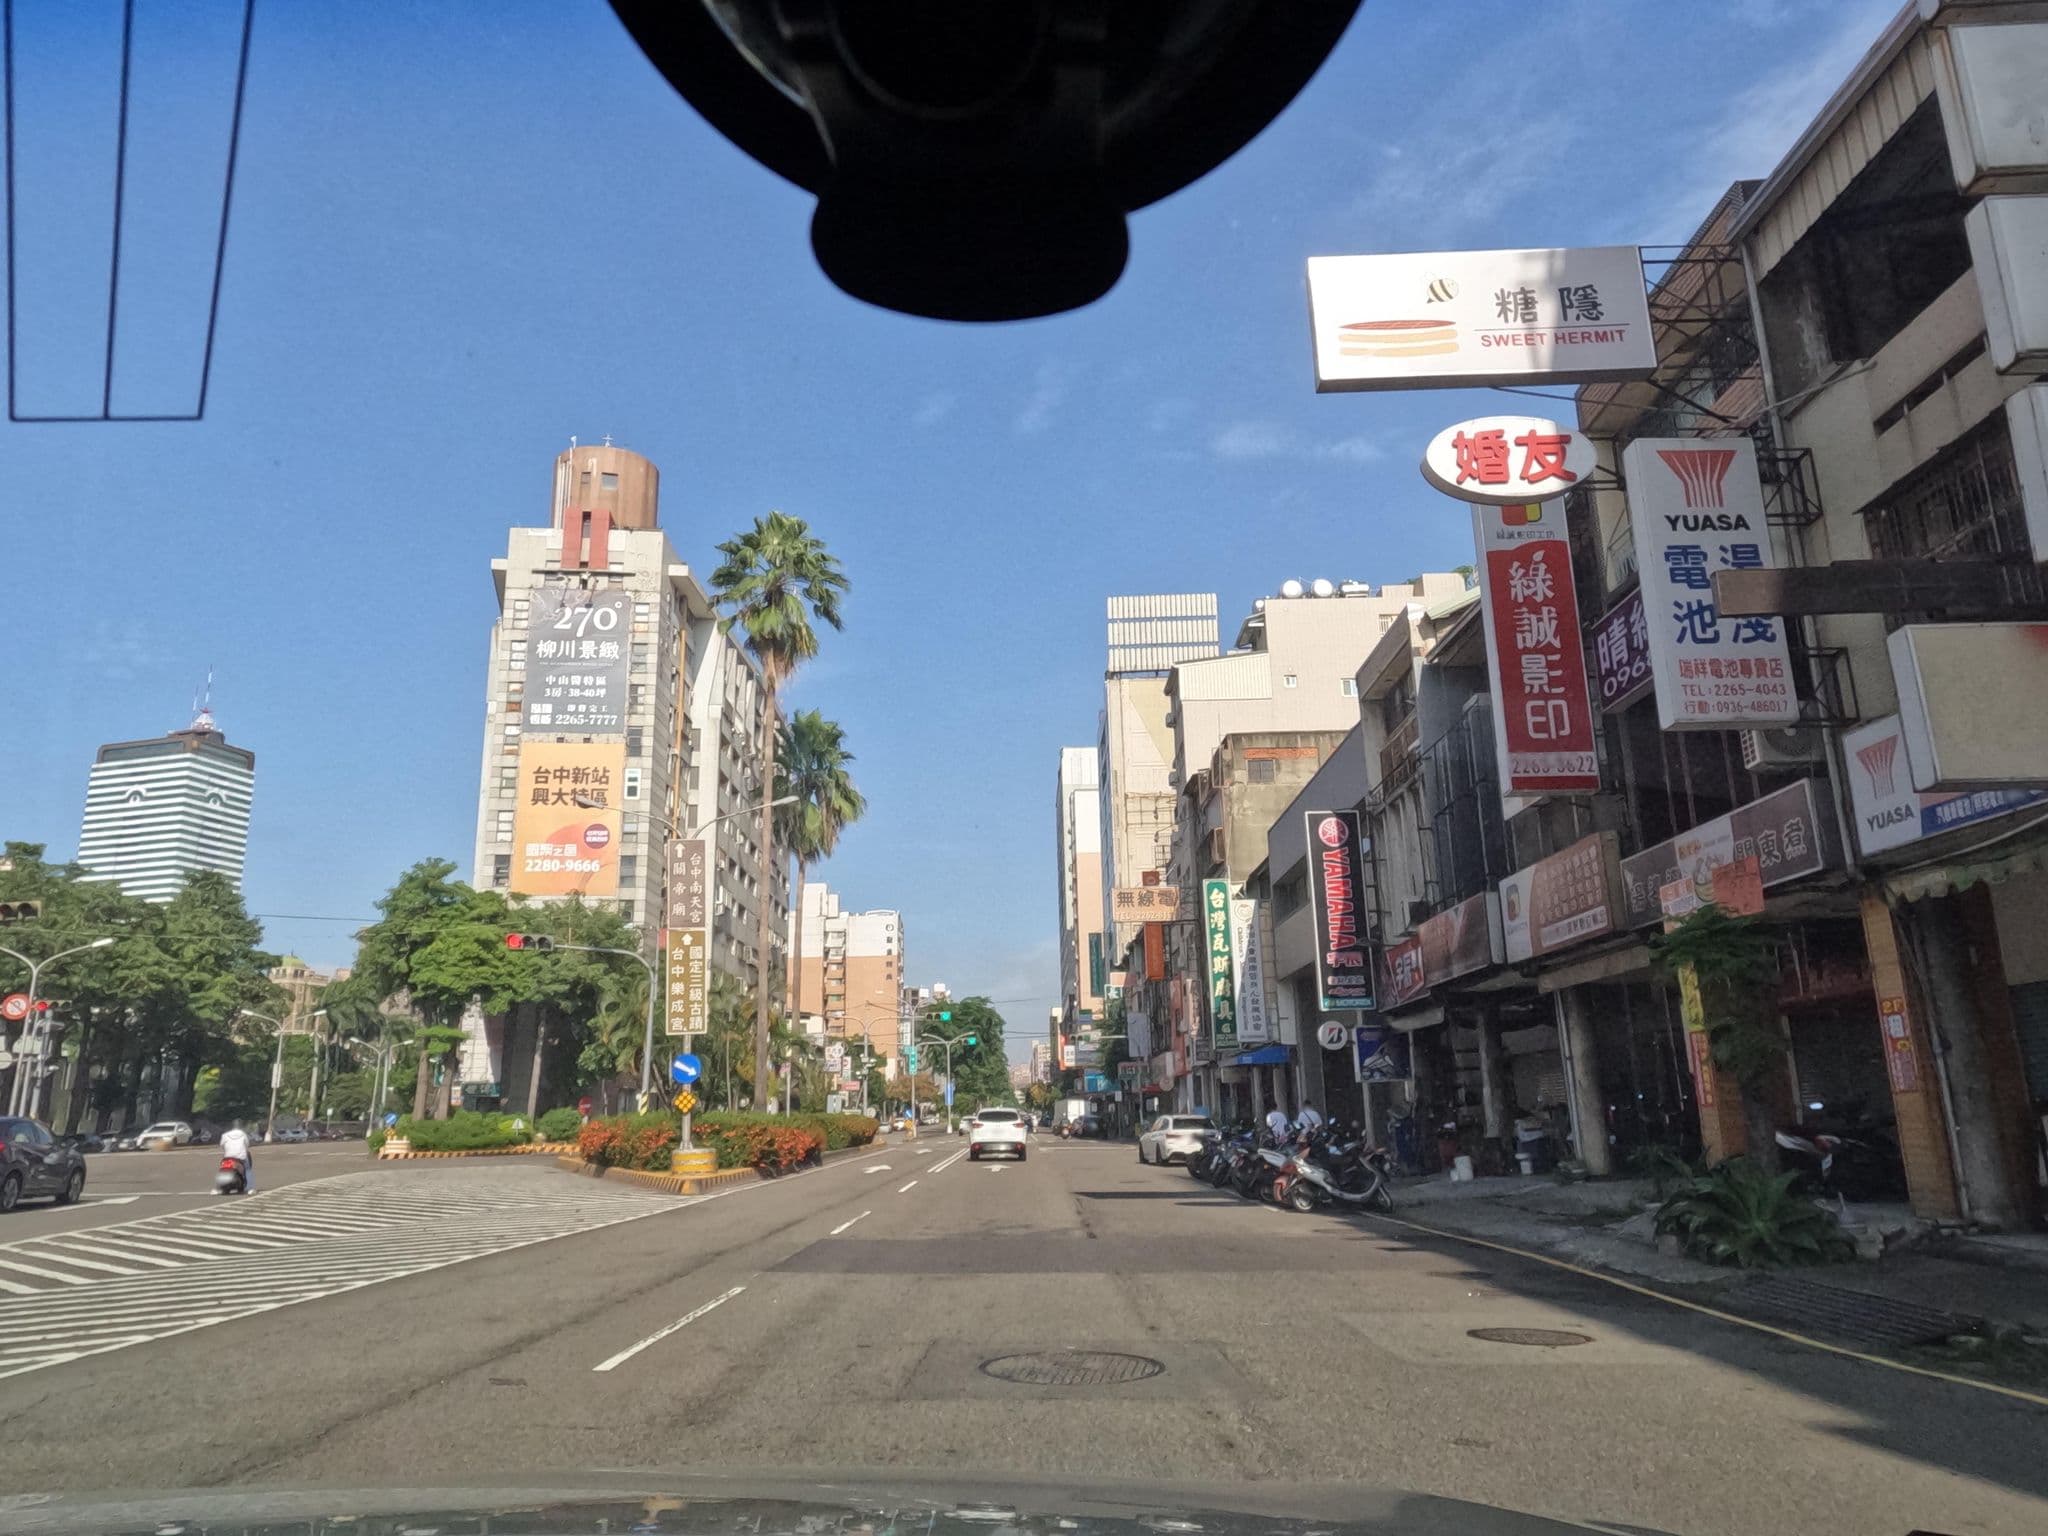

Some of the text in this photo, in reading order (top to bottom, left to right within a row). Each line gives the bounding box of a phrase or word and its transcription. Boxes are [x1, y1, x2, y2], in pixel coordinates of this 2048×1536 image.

[1495, 284, 1604, 323] 糖隱
[1481, 330, 1626, 347] SWEET HERMIT
[1452, 429, 1577, 485] 婚友
[1664, 514, 1751, 532] YUASA
[536, 640, 619, 659] 柳川景緻
[1509, 550, 1572, 740] 綠誠影印
[555, 714, 618, 726] 2265-7777
[533, 766, 611, 785] 台中新站
[531, 787, 609, 806] 興大特區
[1867, 804, 1915, 832] YUASA
[525, 860, 600, 872] 2280-9666
[1323, 848, 1357, 950] YAMAHA
[671, 947, 685, 1031] 台中樂成宮
